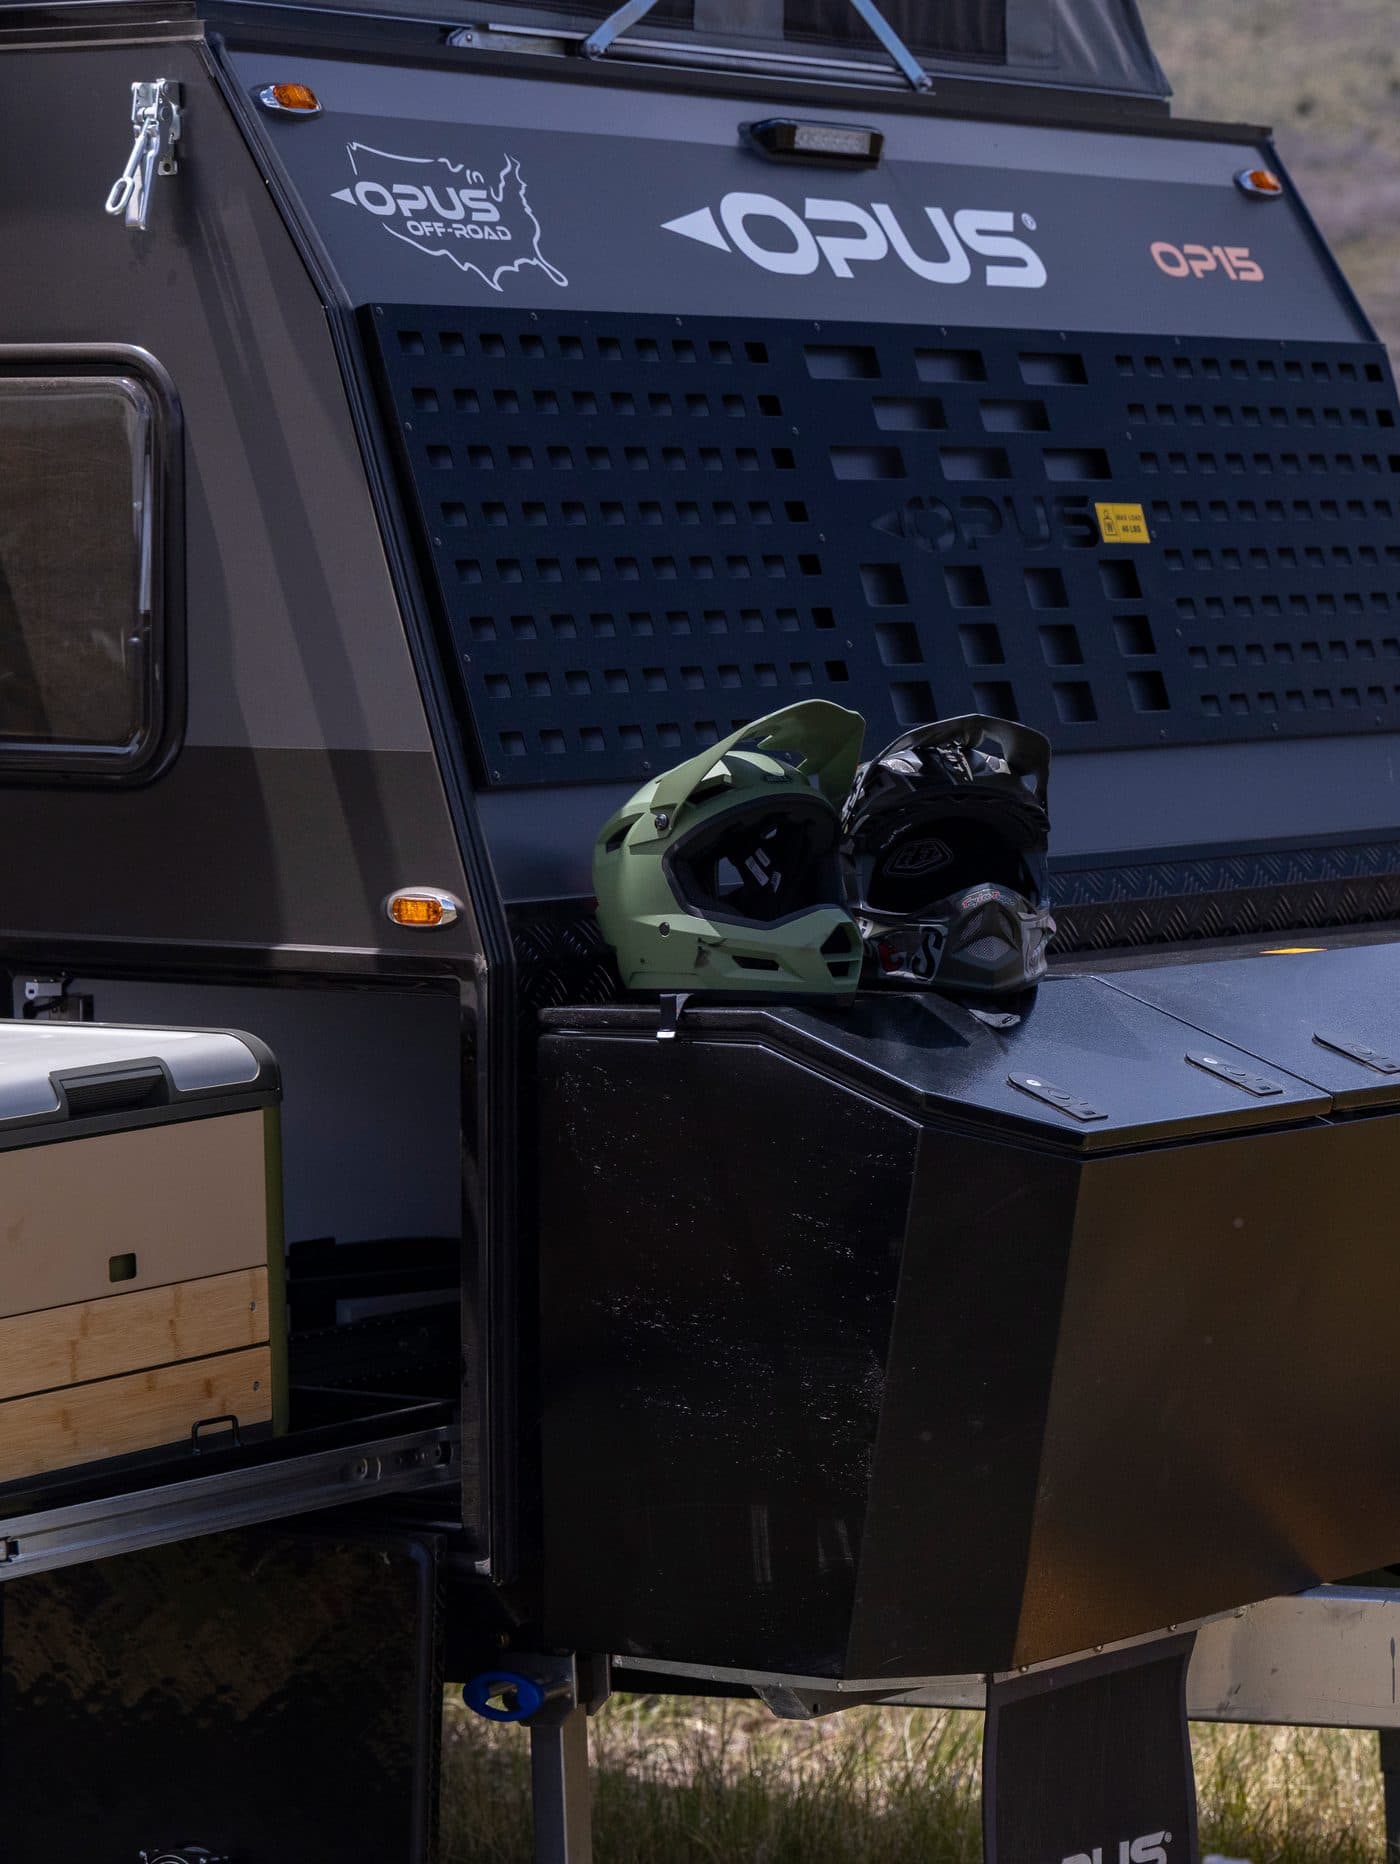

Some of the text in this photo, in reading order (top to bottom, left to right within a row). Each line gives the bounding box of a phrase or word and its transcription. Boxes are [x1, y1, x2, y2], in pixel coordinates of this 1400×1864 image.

[354, 181, 501, 222] OPUS
[406, 221, 512, 240] OFF-ROAD
[720, 192, 1047, 288] OPUS
[1150, 241, 1265, 282] OP15
[902, 495, 1099, 551] OPUS
